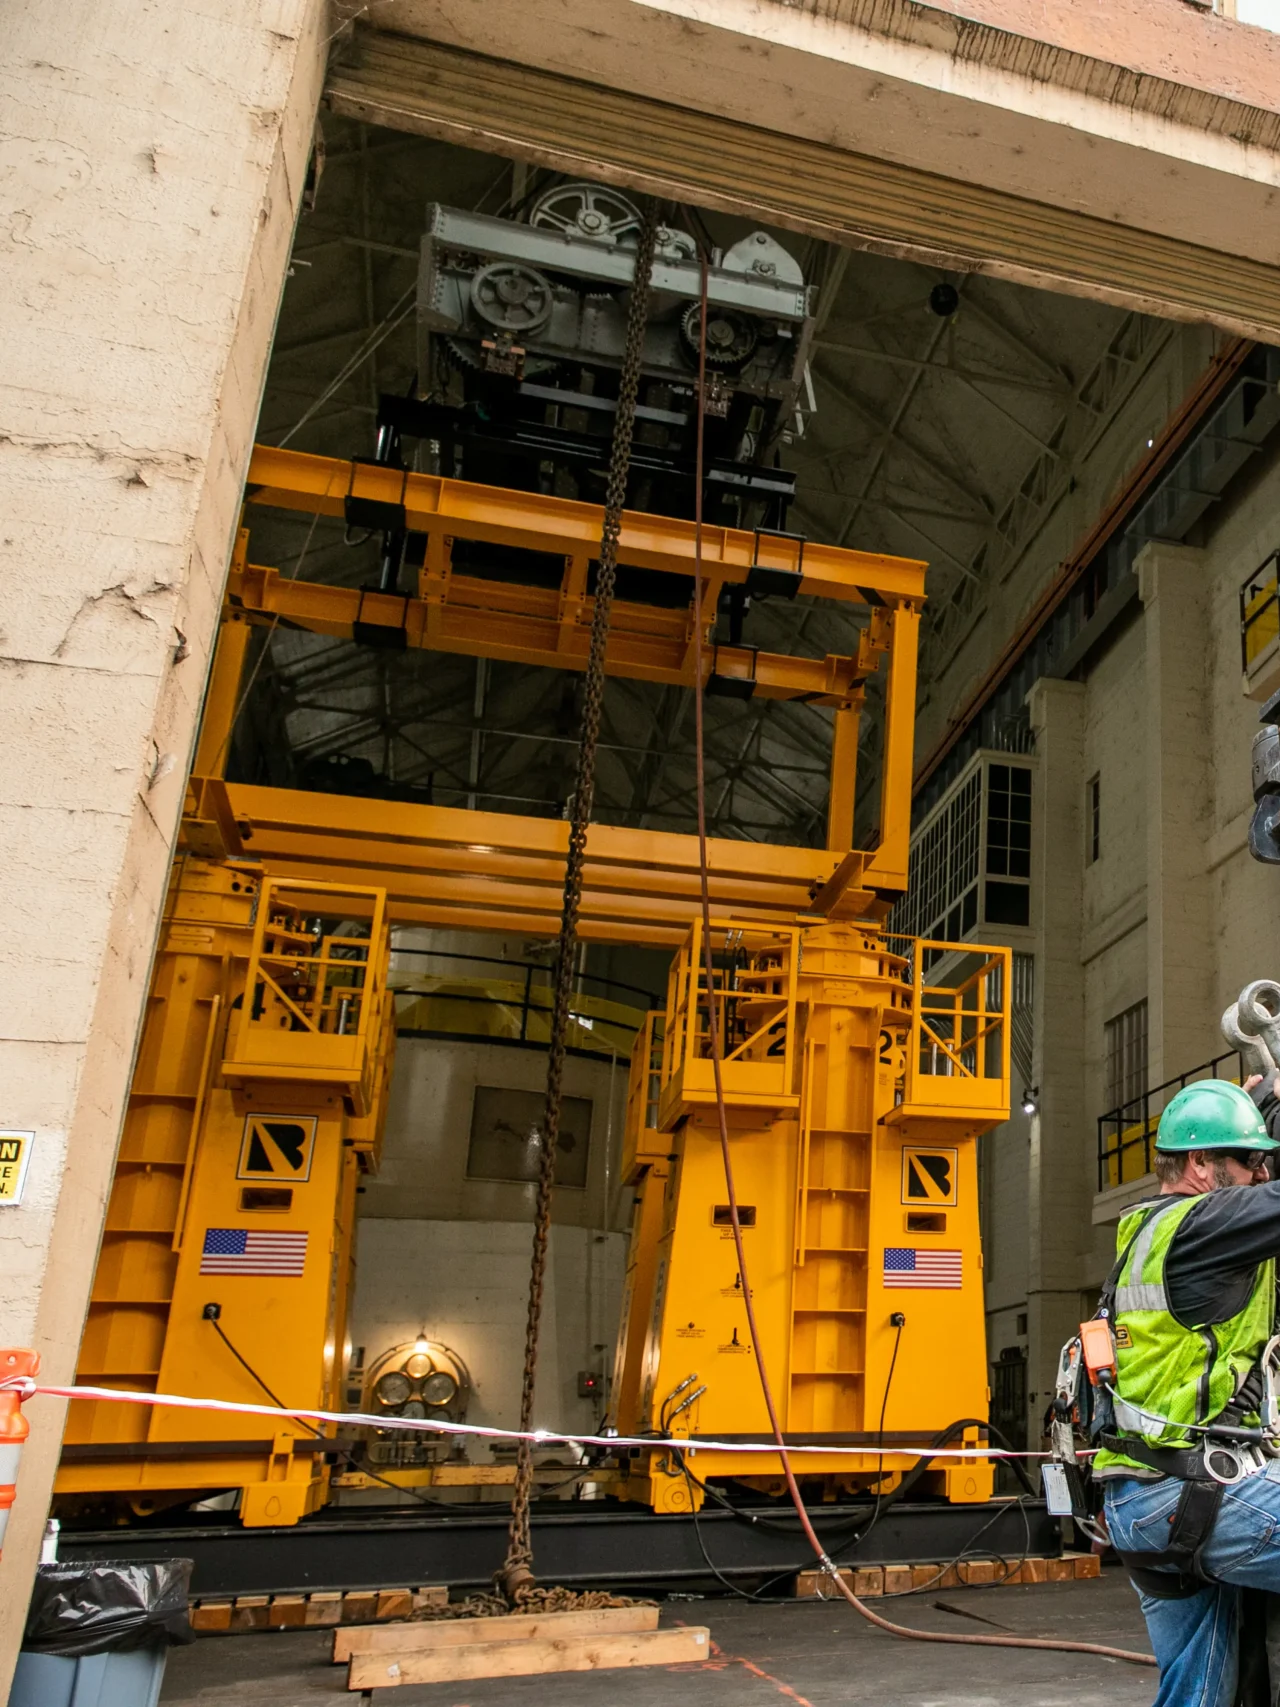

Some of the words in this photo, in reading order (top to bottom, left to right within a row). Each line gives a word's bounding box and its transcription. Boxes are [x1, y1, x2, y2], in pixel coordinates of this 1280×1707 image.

[767, 1022, 786, 1056] 2
[879, 1029, 893, 1065] 2
[0, 1143, 18, 1159] N
